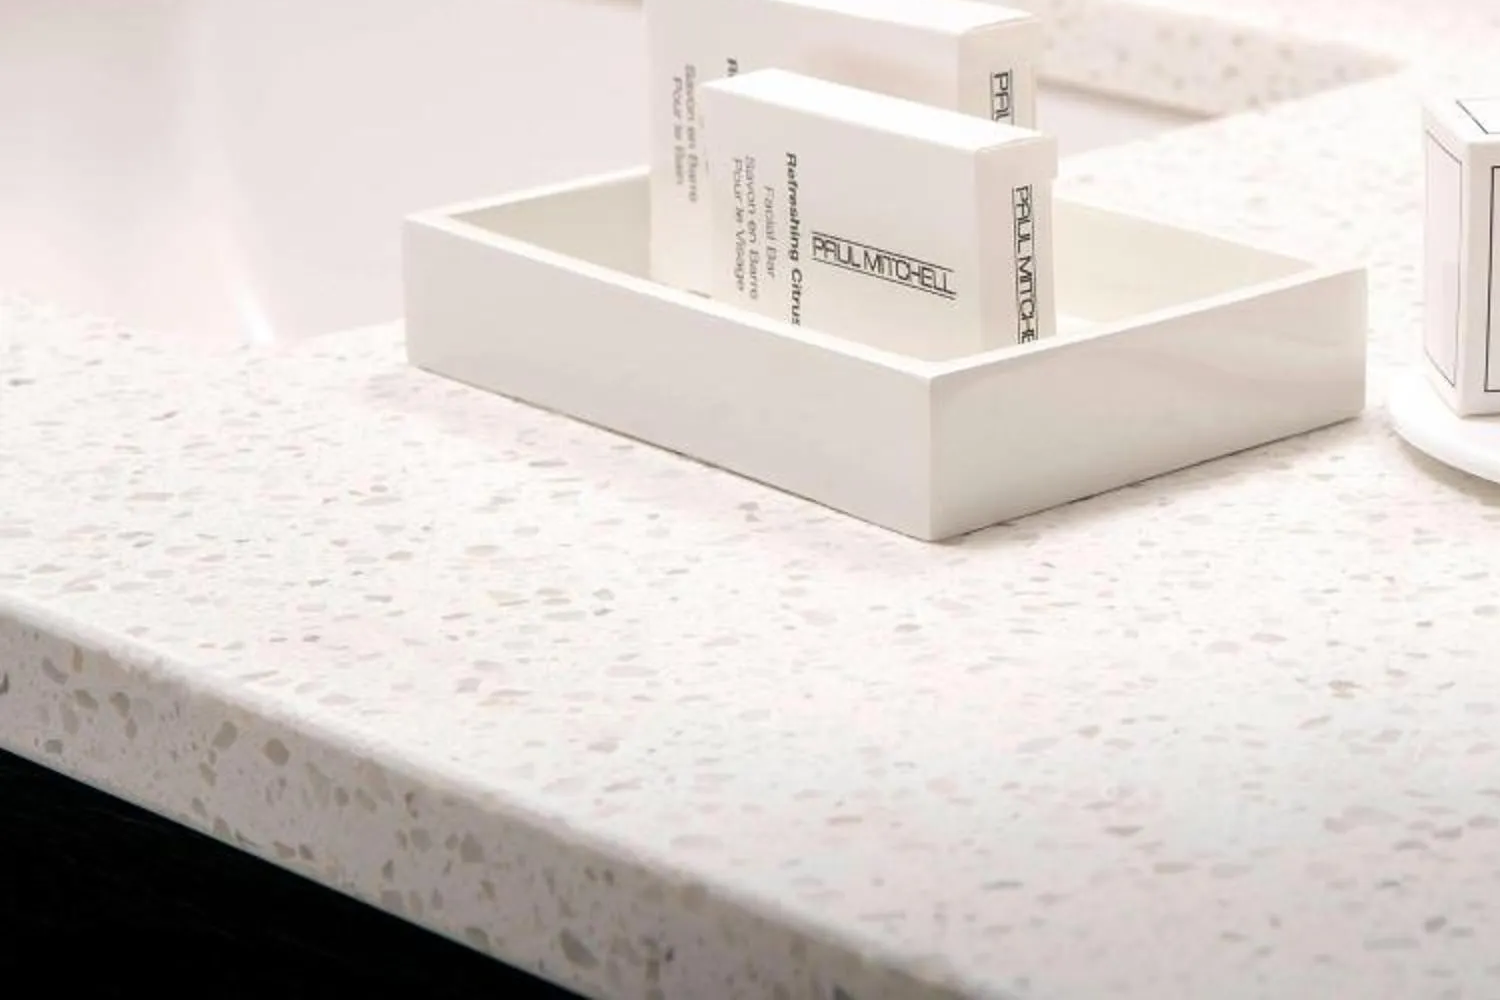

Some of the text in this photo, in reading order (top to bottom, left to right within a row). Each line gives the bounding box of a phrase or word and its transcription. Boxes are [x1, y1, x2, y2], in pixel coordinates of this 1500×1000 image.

[733, 157, 744, 202] Pour
[747, 220, 757, 244] en
[764, 185, 775, 240] Facial
[786, 152, 803, 326] Refreshing Citrus
[811, 235, 955, 295] PAUL MITCHELL
[1014, 185, 1037, 344] PAUL MITCHE
